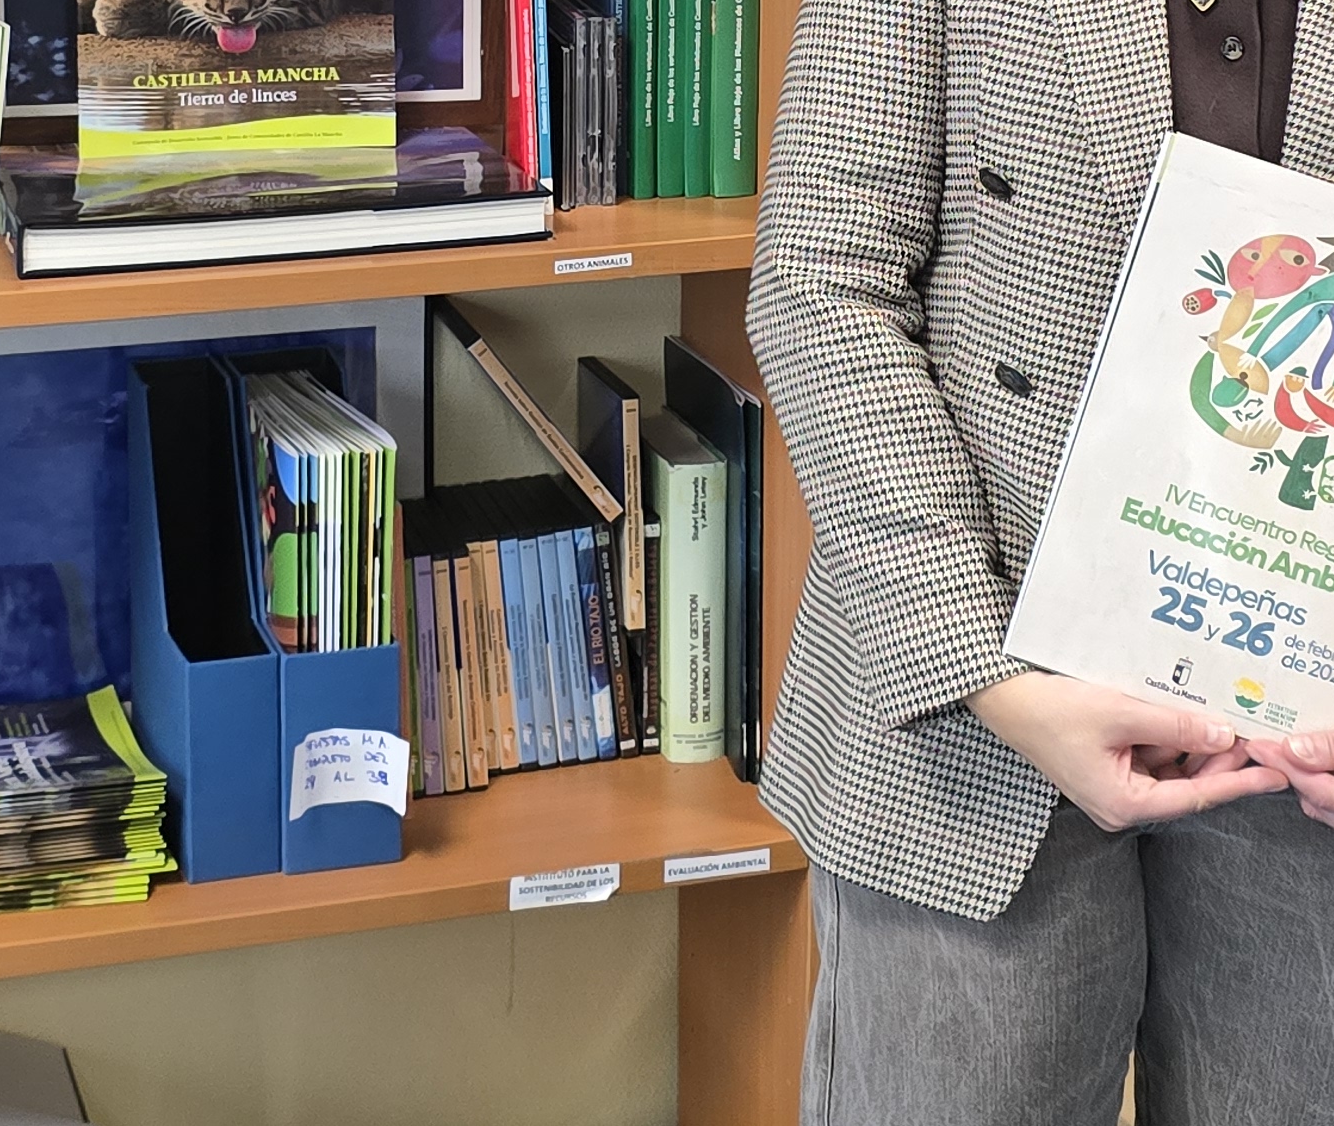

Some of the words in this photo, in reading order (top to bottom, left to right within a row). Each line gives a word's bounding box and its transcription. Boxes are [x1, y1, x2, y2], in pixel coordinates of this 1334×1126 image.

[133, 70, 252, 88] CASTILLA-LA
[257, 67, 341, 84] MANCHA
[178, 92, 225, 107] Tierra
[228, 90, 246, 104] de
[252, 88, 297, 103] linces
[557, 261, 585, 272] OTROS
[586, 257, 629, 269] ANIMALES
[1165, 483, 1189, 507] IV
[1188, 490, 1298, 543] Encuentro
[1119, 496, 1268, 571] Educación
[1149, 549, 1307, 626] Valdepeñas
[588, 595, 601, 626] TAJO
[688, 593, 698, 641] GESTION
[1150, 586, 1208, 632] 25
[1203, 624, 1221, 641] y
[1221, 611, 1276, 656] 26
[701, 607, 711, 664] AMBIENTE
[1284, 635, 1307, 652] de
[592, 648, 605, 665] EL
[1280, 653, 1307, 673] de
[615, 673, 626, 704] TAJO
[689, 654, 699, 724] ORDENACION
[701, 666, 711, 702] MEDIO
[1145, 676, 1180, 698] Castilla-La
[701, 702, 711, 723] DEL
[668, 862, 720, 877] EVALUACIÓN
[721, 857, 767, 871] AMBIENTAL
[518, 880, 585, 895] SOSTENIBILIDAD
[586, 879, 597, 888] DE
[598, 877, 615, 887] LOS
